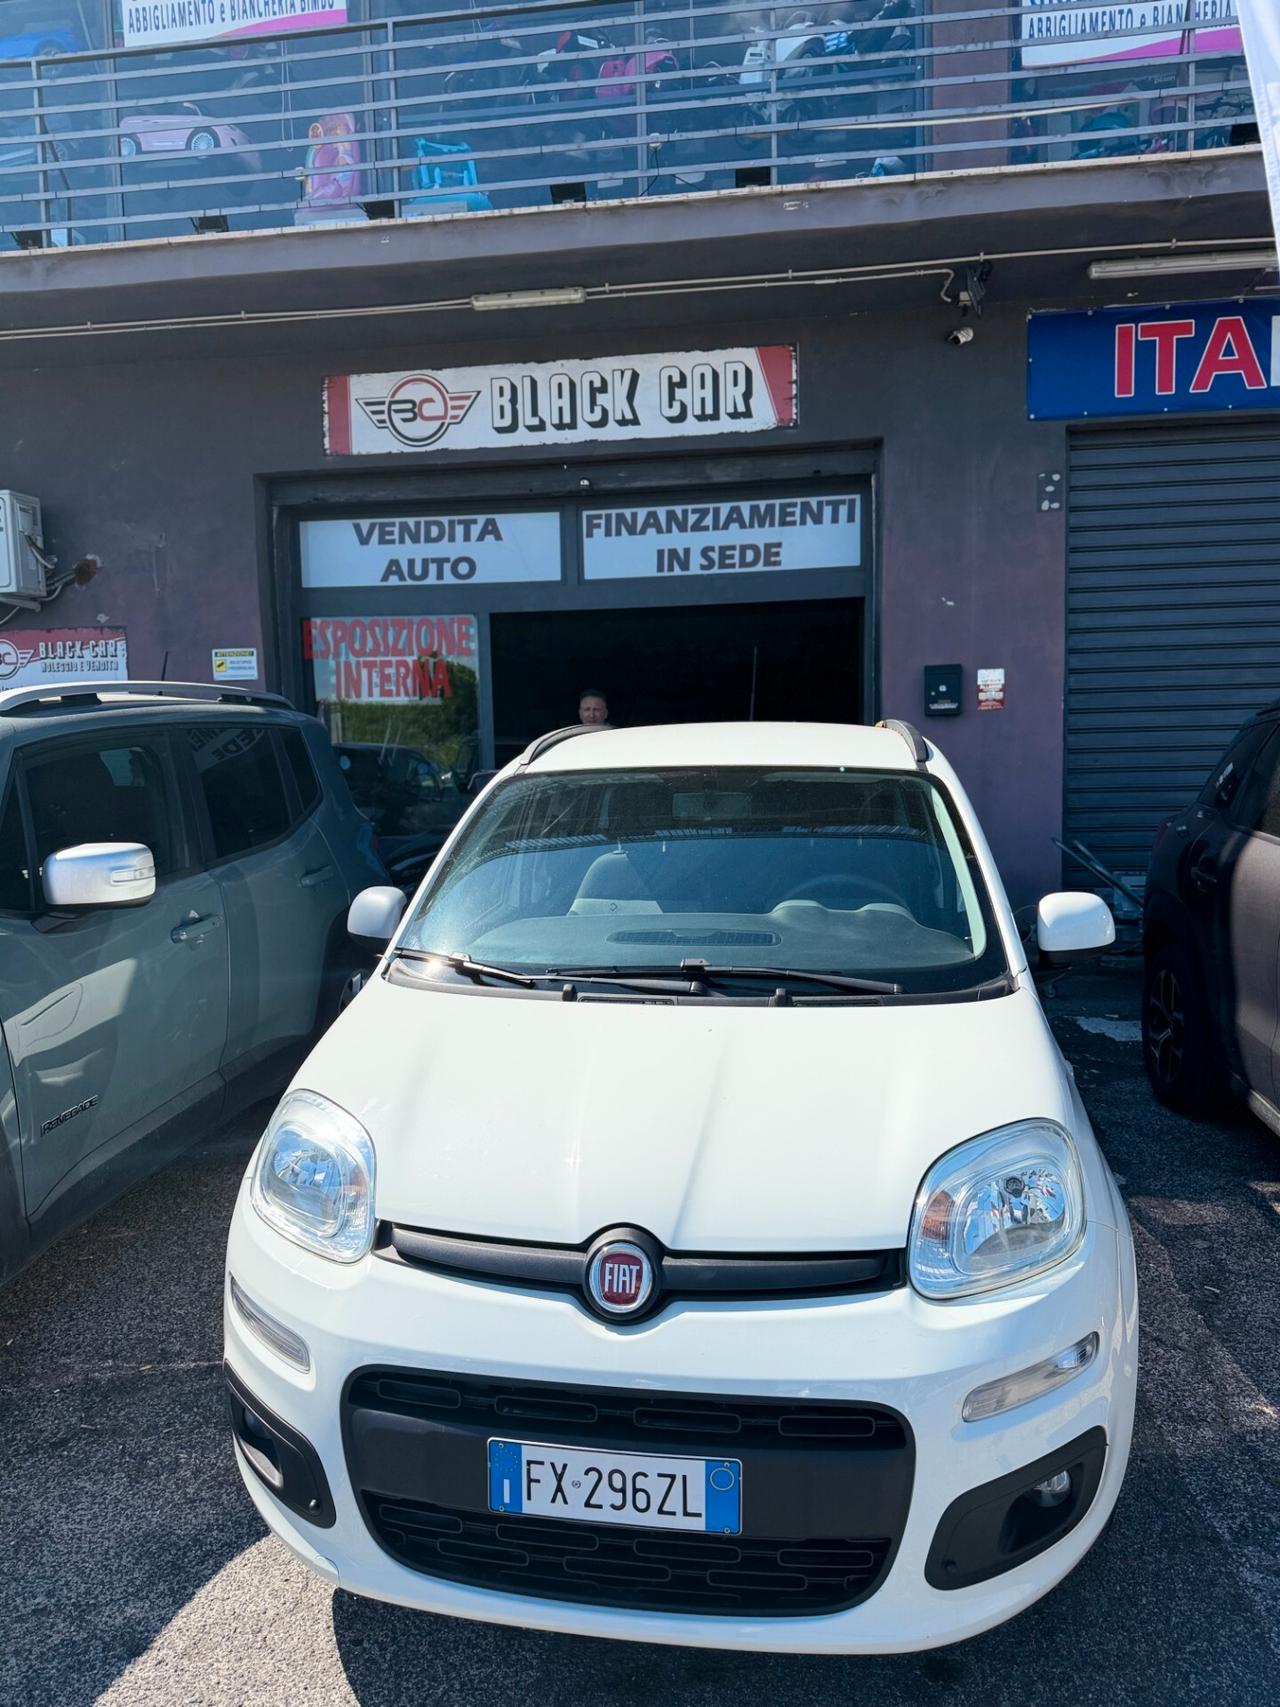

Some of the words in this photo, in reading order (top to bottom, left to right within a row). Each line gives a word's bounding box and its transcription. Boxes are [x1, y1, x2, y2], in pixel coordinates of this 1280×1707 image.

[128, 0, 215, 34] ABBIGLIAMENTO
[220, 2, 226, 22] e
[230, 0, 297, 21] BIANCHERIA
[1153, 0, 1233, 27] BIANHERIA
[1113, 315, 1280, 397] ITA
[490, 368, 641, 434] BLACK
[659, 360, 753, 424] CAR
[352, 517, 504, 546] VENDITA
[585, 498, 857, 538] FINANZIAMENTI
[380, 555, 477, 582] AUTO
[656, 547, 691, 573] IN
[699, 541, 783, 572] SEDE
[39, 640, 85, 660] BLACK
[89, 639, 118, 658] CAR
[303, 616, 473, 660] ESPOSIZIONE
[335, 657, 452, 700] INTERNA
[40, 1095, 99, 1138] RENEGADE
[604, 1263, 640, 1294] FIAT
[526, 1460, 569, 1505] FX
[584, 1466, 703, 1518] 296ZL
